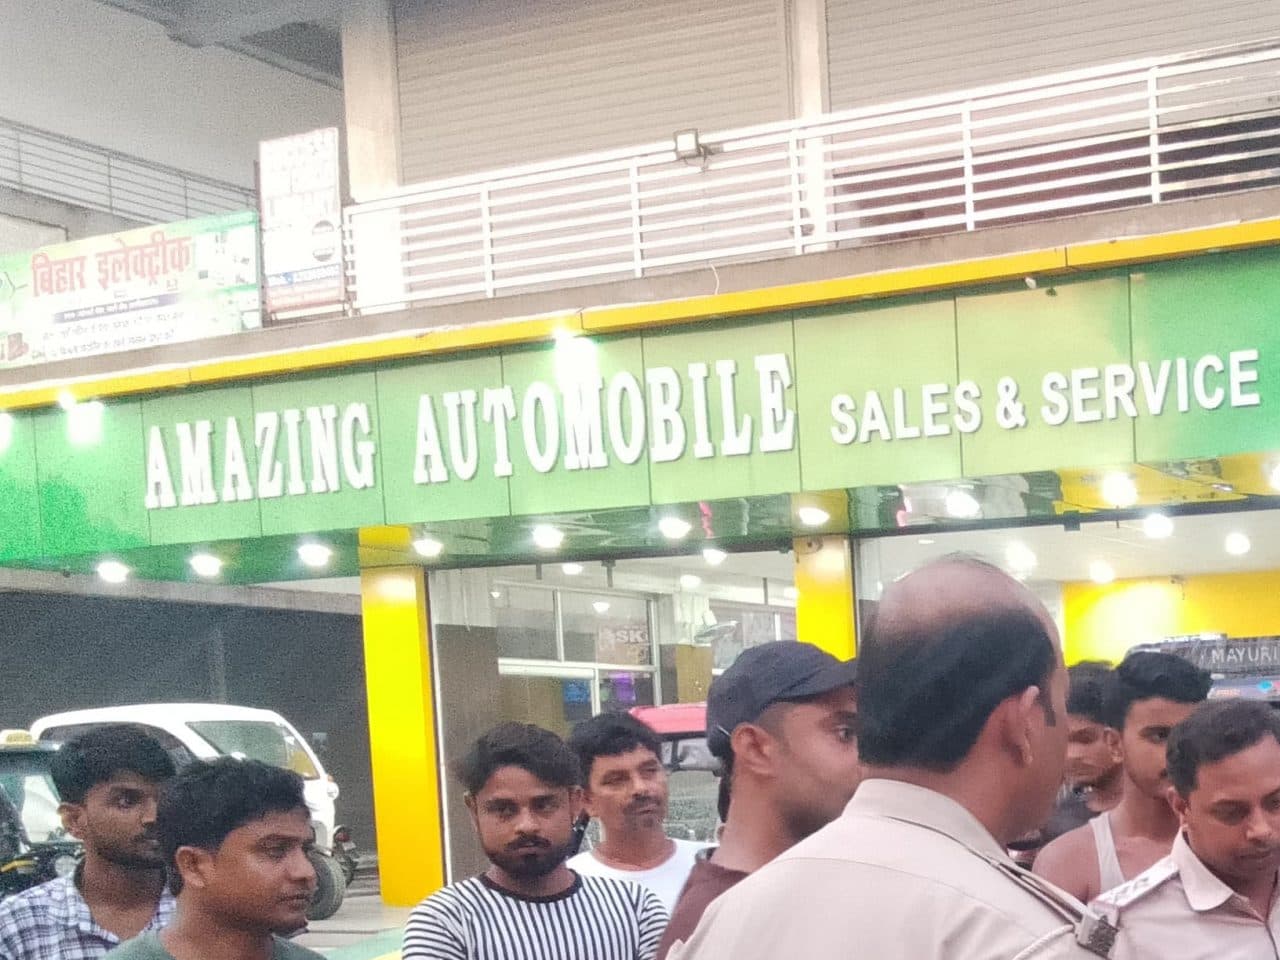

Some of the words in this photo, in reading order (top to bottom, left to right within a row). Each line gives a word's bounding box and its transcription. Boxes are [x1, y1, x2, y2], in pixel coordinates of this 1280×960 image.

[32, 251, 88, 297] बिहार
[145, 401, 379, 511] AMAZING
[413, 353, 796, 486] AUTOMOBILE
[829, 379, 983, 445] SALES
[996, 376, 1027, 430] &
[1041, 349, 1261, 426] SERVICE
[1211, 647, 1278, 664] MAYURI
